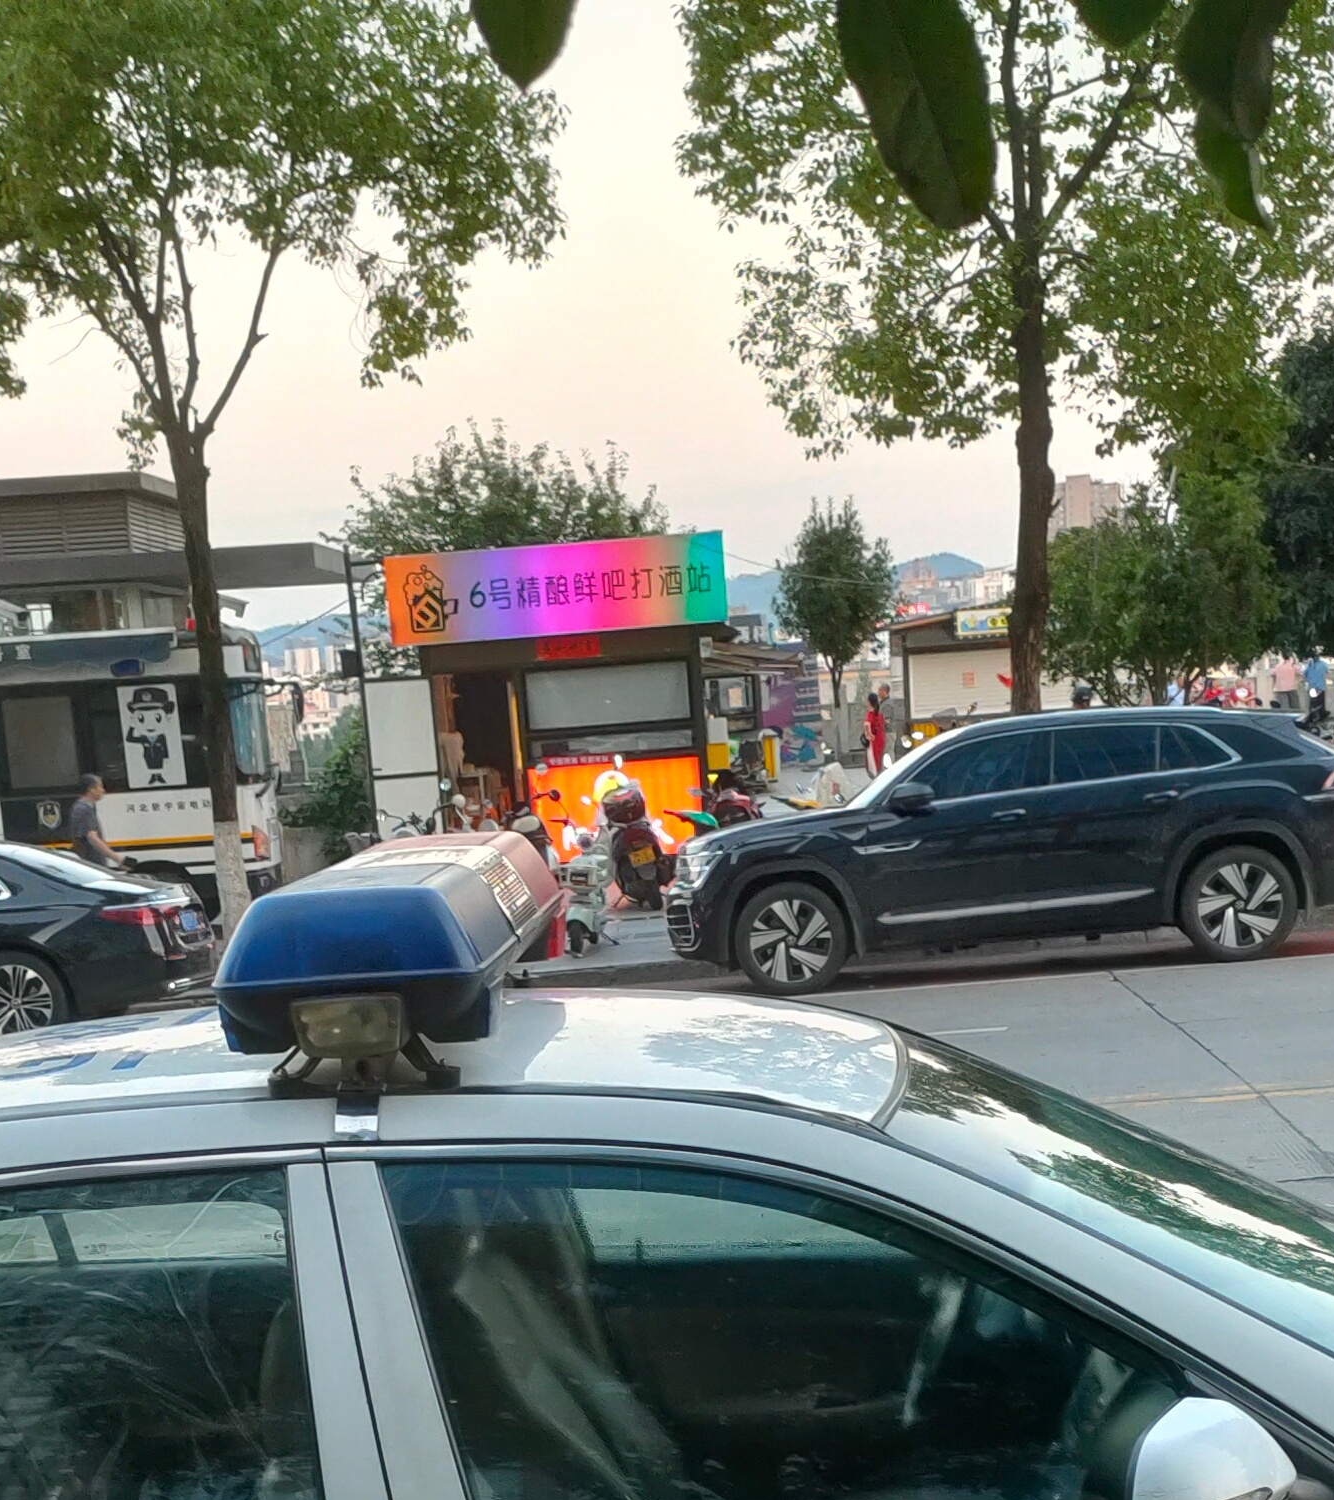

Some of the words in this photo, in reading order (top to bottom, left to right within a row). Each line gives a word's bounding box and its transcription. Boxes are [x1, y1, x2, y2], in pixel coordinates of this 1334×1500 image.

[469, 562, 712, 609] 6号精酿鲜吧打酒站
